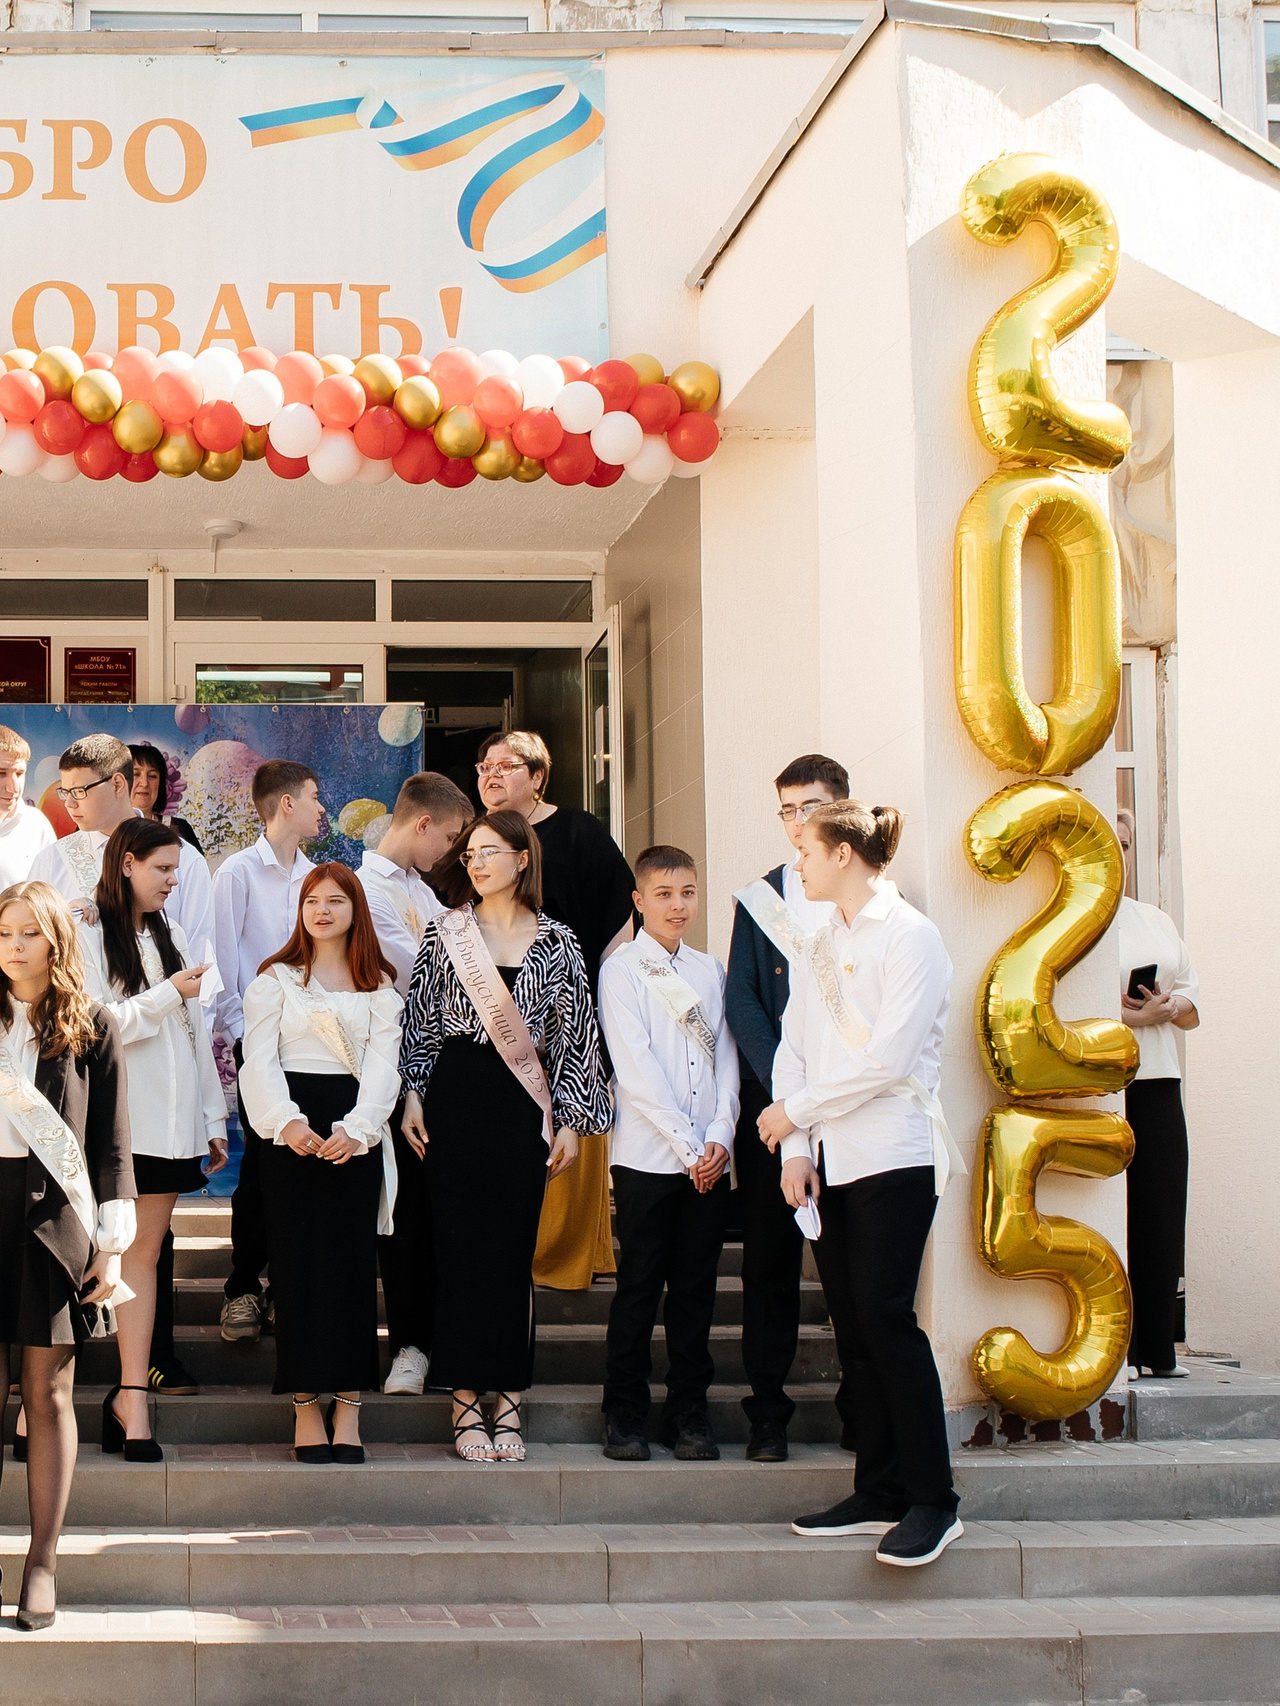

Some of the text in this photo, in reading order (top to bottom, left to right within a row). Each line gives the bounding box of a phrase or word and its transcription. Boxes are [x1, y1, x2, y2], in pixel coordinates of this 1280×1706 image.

[455, 936, 547, 1094] Выпускница 2025
[954, 150, 1141, 1421] 2025
